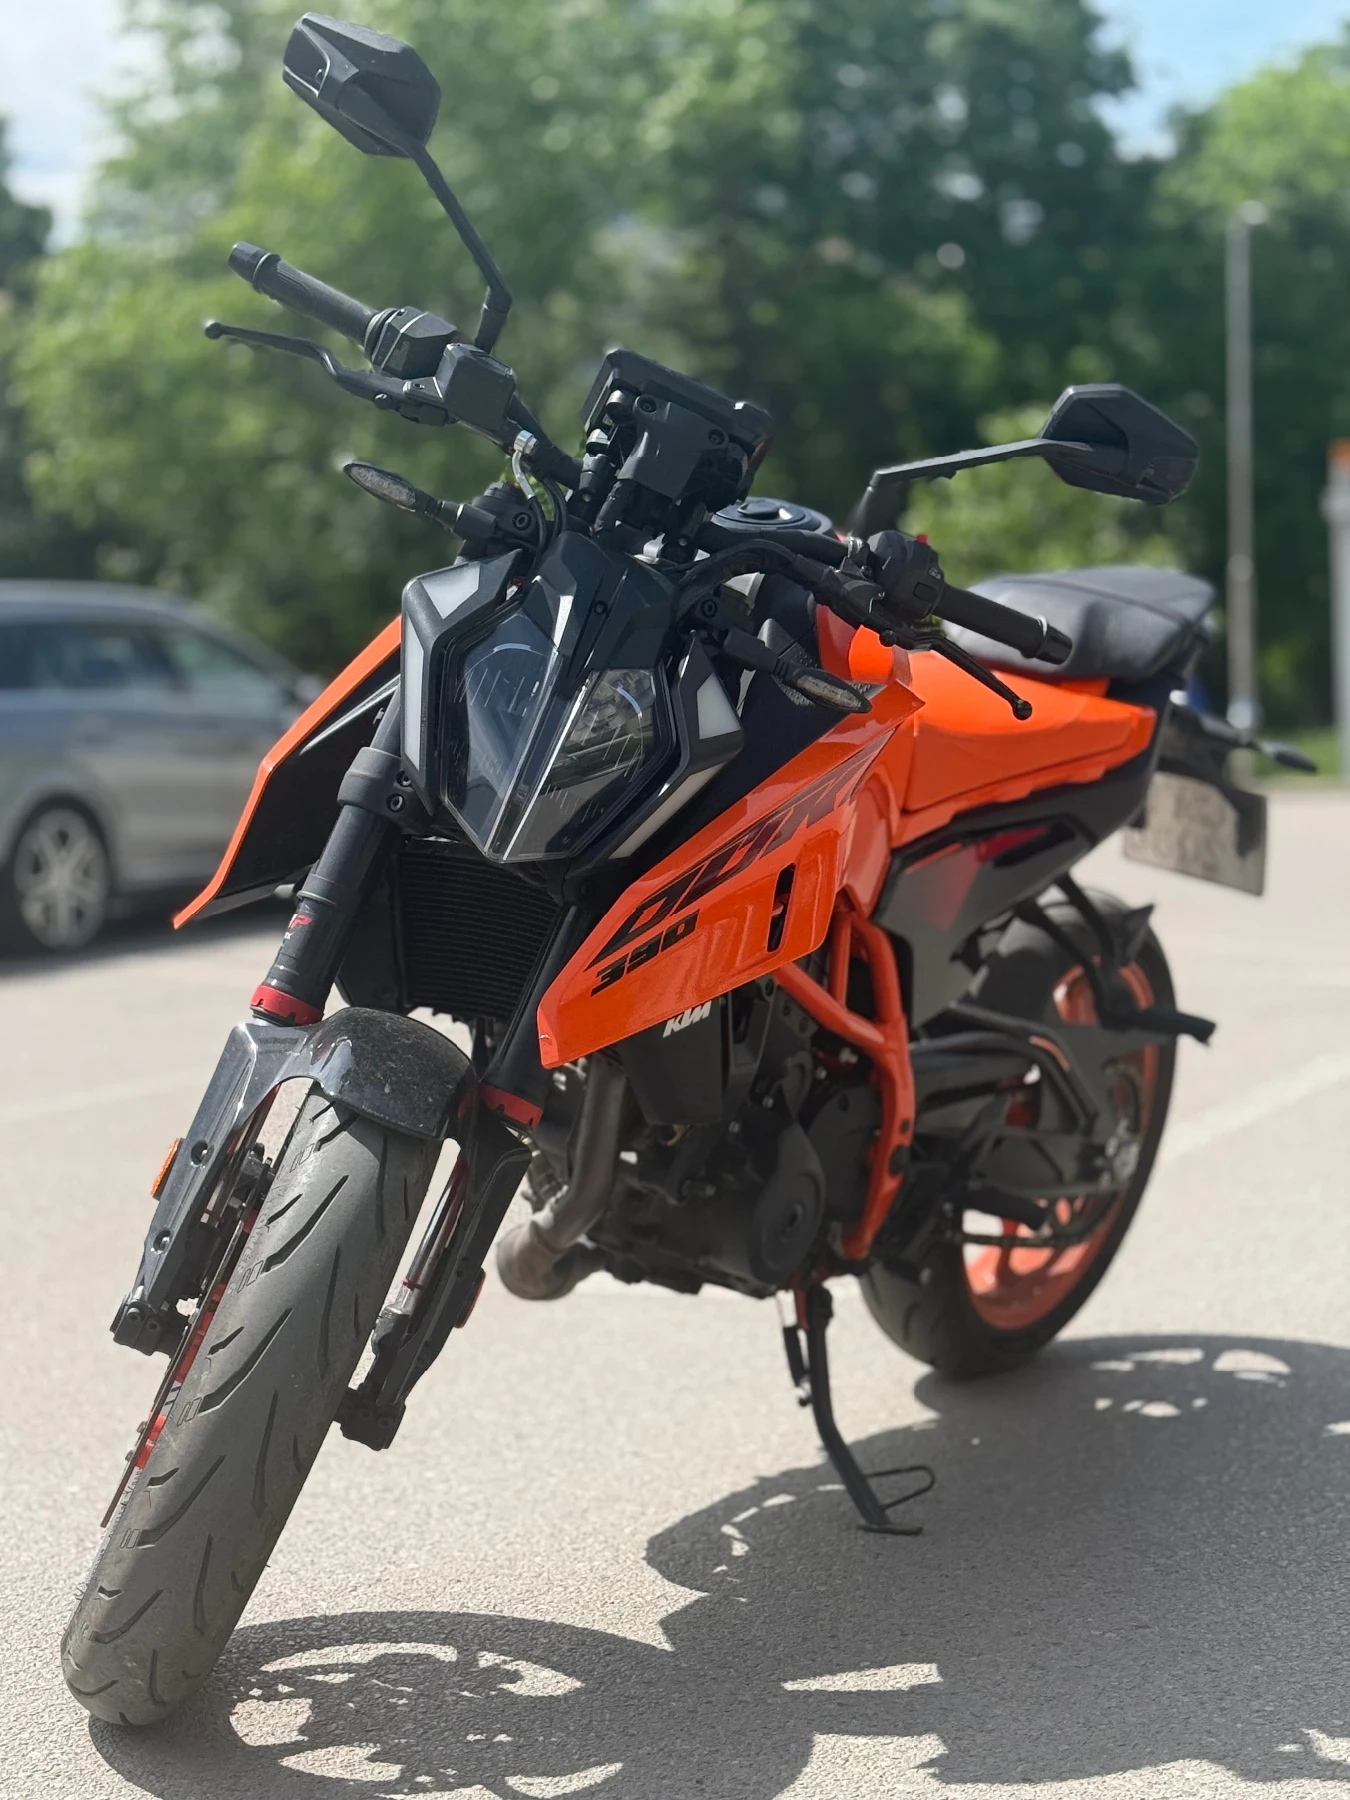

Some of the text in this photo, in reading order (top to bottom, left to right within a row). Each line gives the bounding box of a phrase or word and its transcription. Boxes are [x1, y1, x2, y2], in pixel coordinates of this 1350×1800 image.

[583, 753, 872, 972] DUK
[590, 908, 700, 997] 390
[662, 1000, 712, 1038] KTM
